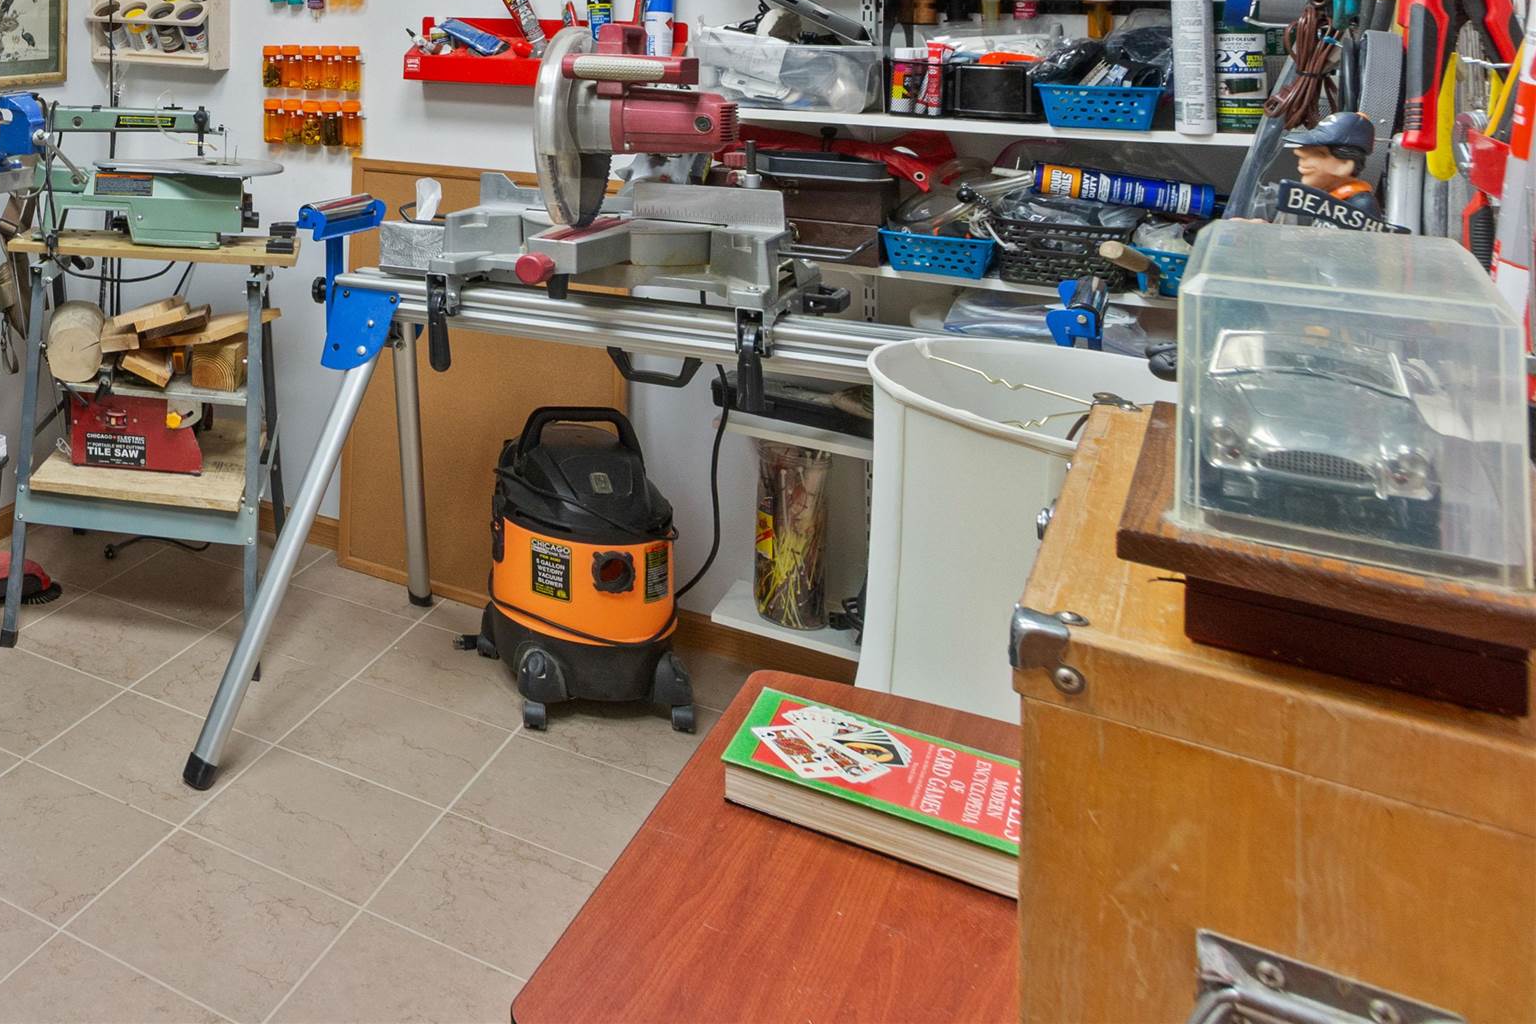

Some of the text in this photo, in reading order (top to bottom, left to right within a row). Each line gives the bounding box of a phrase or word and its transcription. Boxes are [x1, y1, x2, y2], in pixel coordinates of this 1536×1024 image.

[1088, 176, 1099, 198] DUTY
[86, 432, 113, 440] CHICAGO
[87, 446, 139, 458] TILE SAW
[531, 539, 571, 553] CHICAGO
[537, 565, 564, 576] WET/DRY
[540, 559, 565, 570] GALLON
[537, 571, 564, 583] VACUUM
[537, 577, 564, 589] BLOWER
[931, 747, 957, 778] CARD
[949, 779, 965, 794] OF
[961, 759, 992, 825] ENCYCLOPEDIA
[919, 777, 947, 816] GAMES
[986, 778, 1009, 820] MODERN
